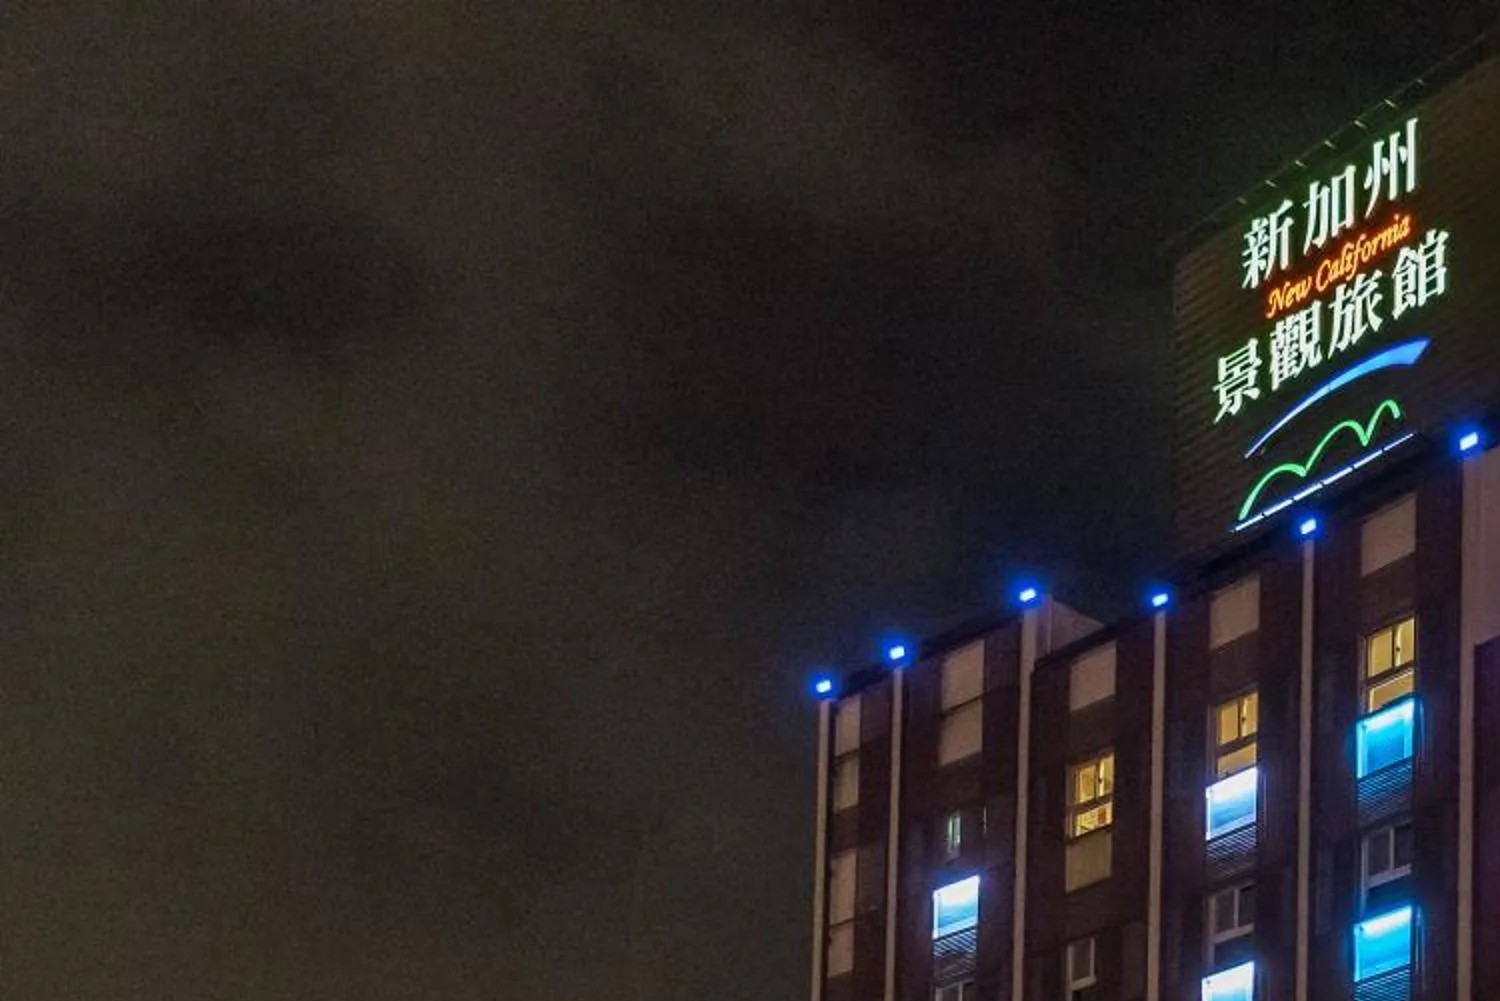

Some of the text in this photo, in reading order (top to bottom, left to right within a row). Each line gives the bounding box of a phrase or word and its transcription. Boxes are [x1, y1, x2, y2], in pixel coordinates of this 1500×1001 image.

[1241, 117, 1419, 289] 新加州
[1265, 213, 1411, 319] New California
[1213, 229, 1450, 424] 景觀旅館
